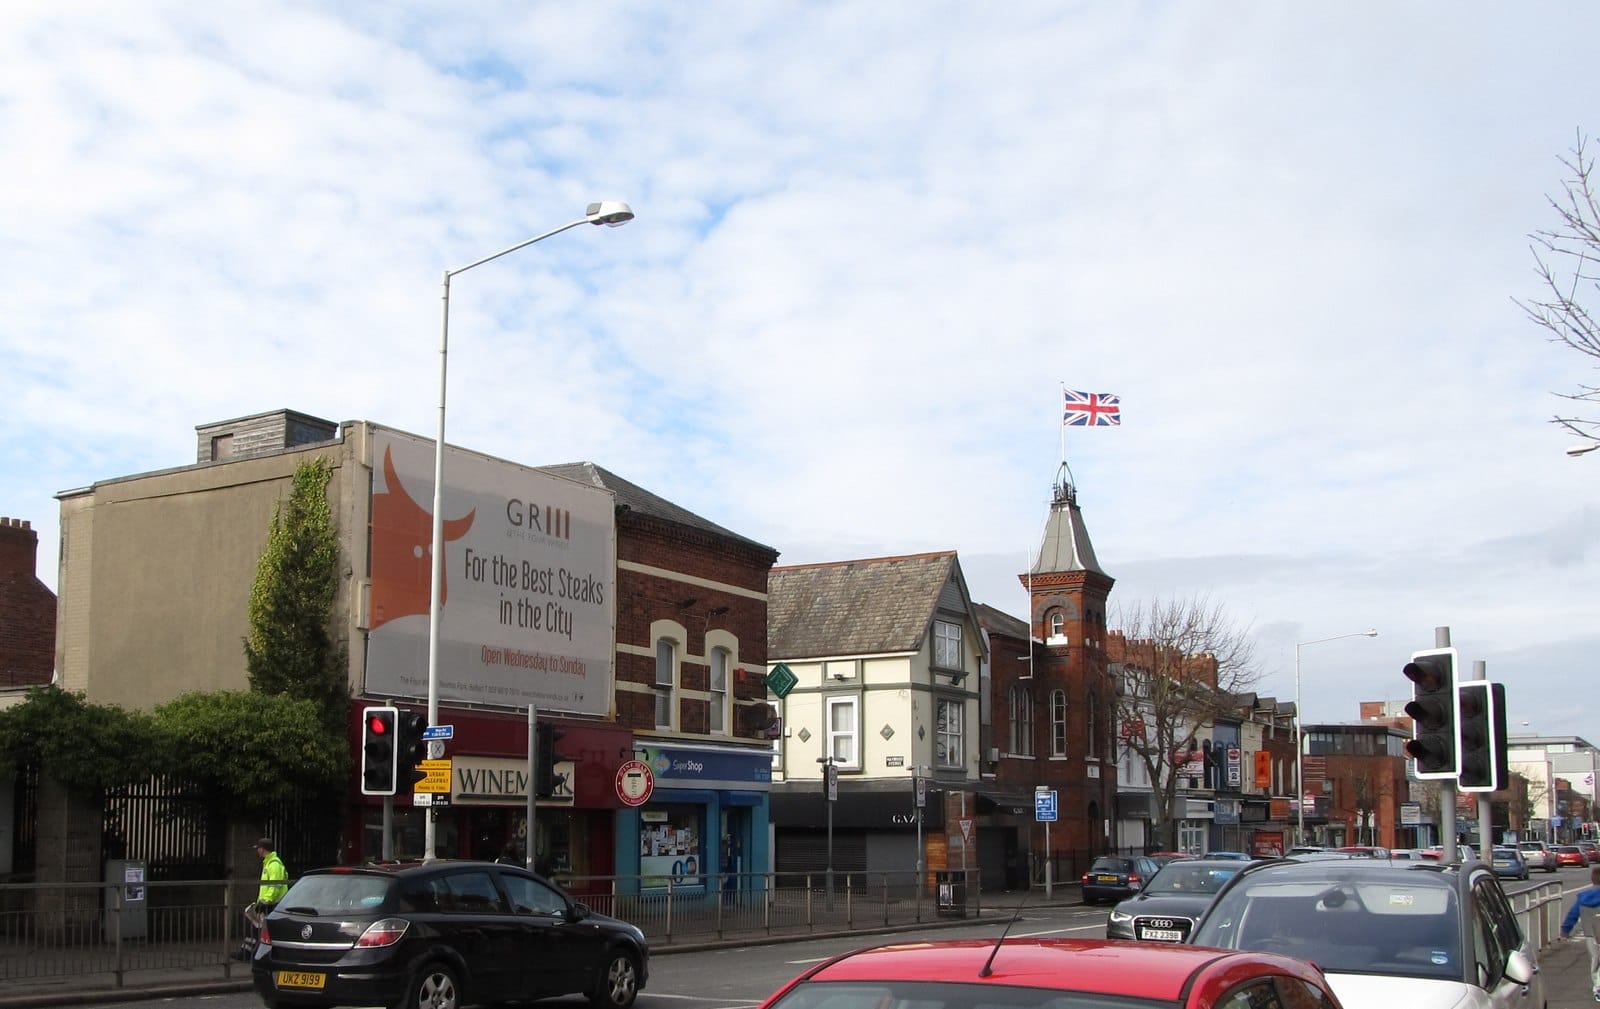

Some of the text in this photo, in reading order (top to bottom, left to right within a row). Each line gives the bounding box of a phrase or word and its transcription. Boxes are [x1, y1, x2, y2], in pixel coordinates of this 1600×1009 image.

[465, 548, 603, 605] For the Best Steaks
[500, 592, 572, 641] in the City
[481, 644, 585, 679] Open Wednesday to Sunday
[458, 768, 574, 795] WINEMK
[672, 759, 703, 774] SuperShop
[283, 973, 320, 985] UKZ 9199
